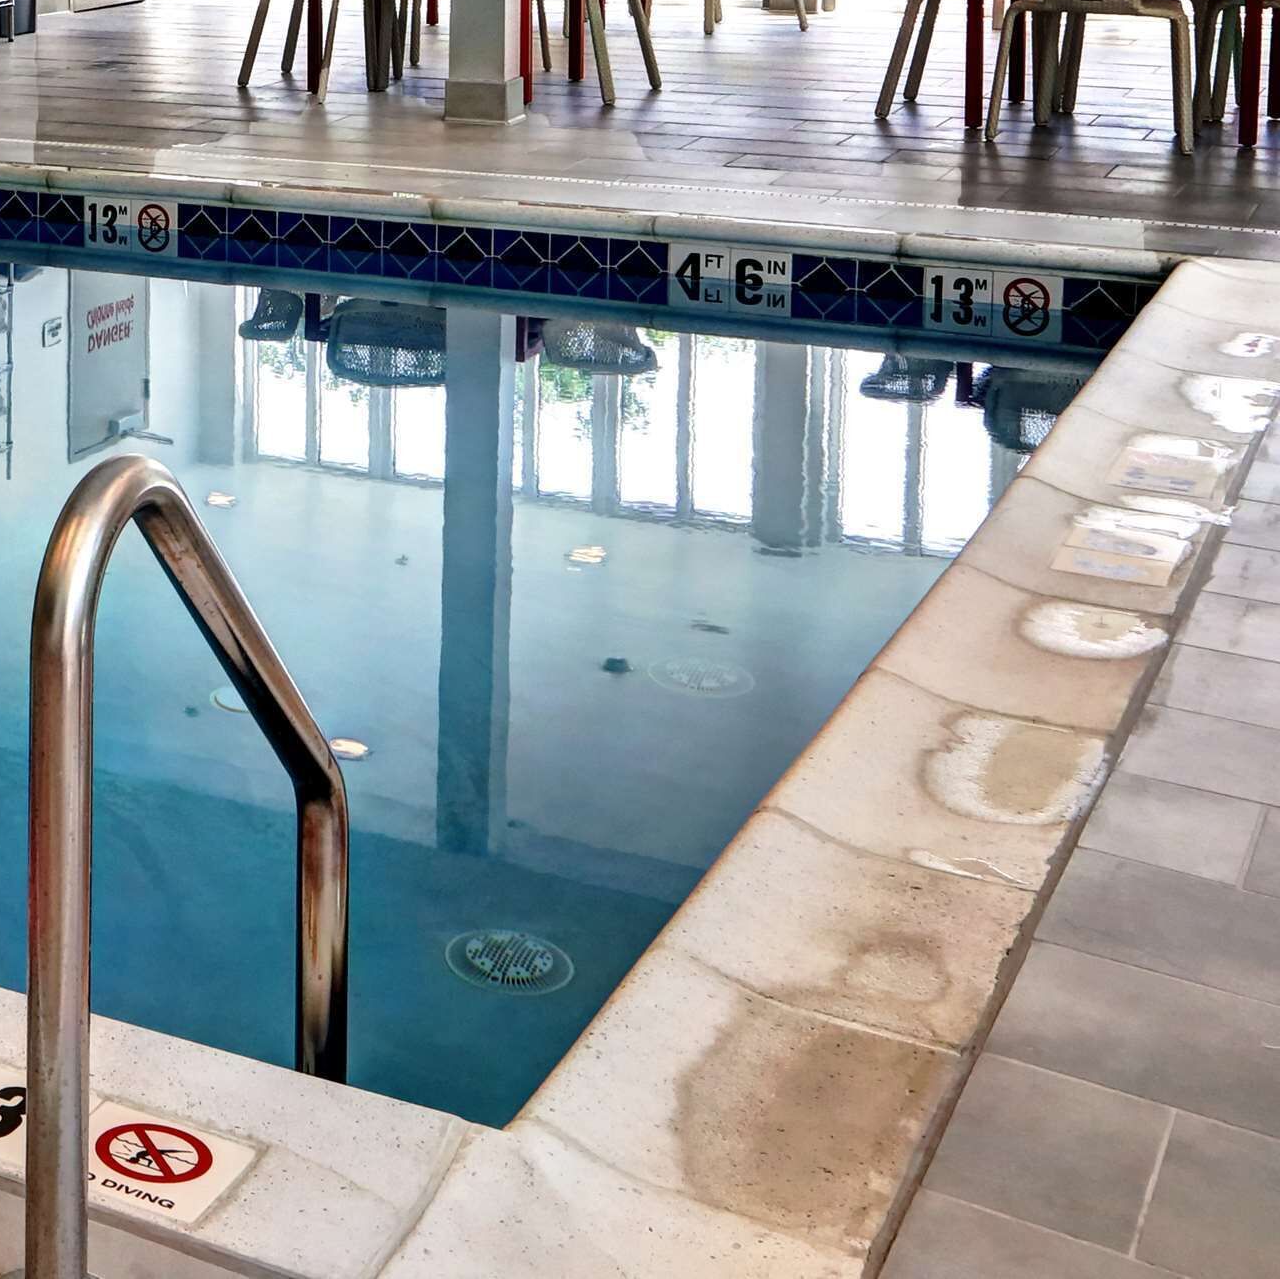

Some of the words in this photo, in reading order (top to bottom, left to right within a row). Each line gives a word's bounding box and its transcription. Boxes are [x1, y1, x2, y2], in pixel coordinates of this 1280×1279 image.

[119, 205, 127, 216] M
[705, 255, 724, 269] FT
[767, 260, 785, 276] IN
[975, 279, 987, 291] M
[101, 1179, 175, 1209] DIVING
